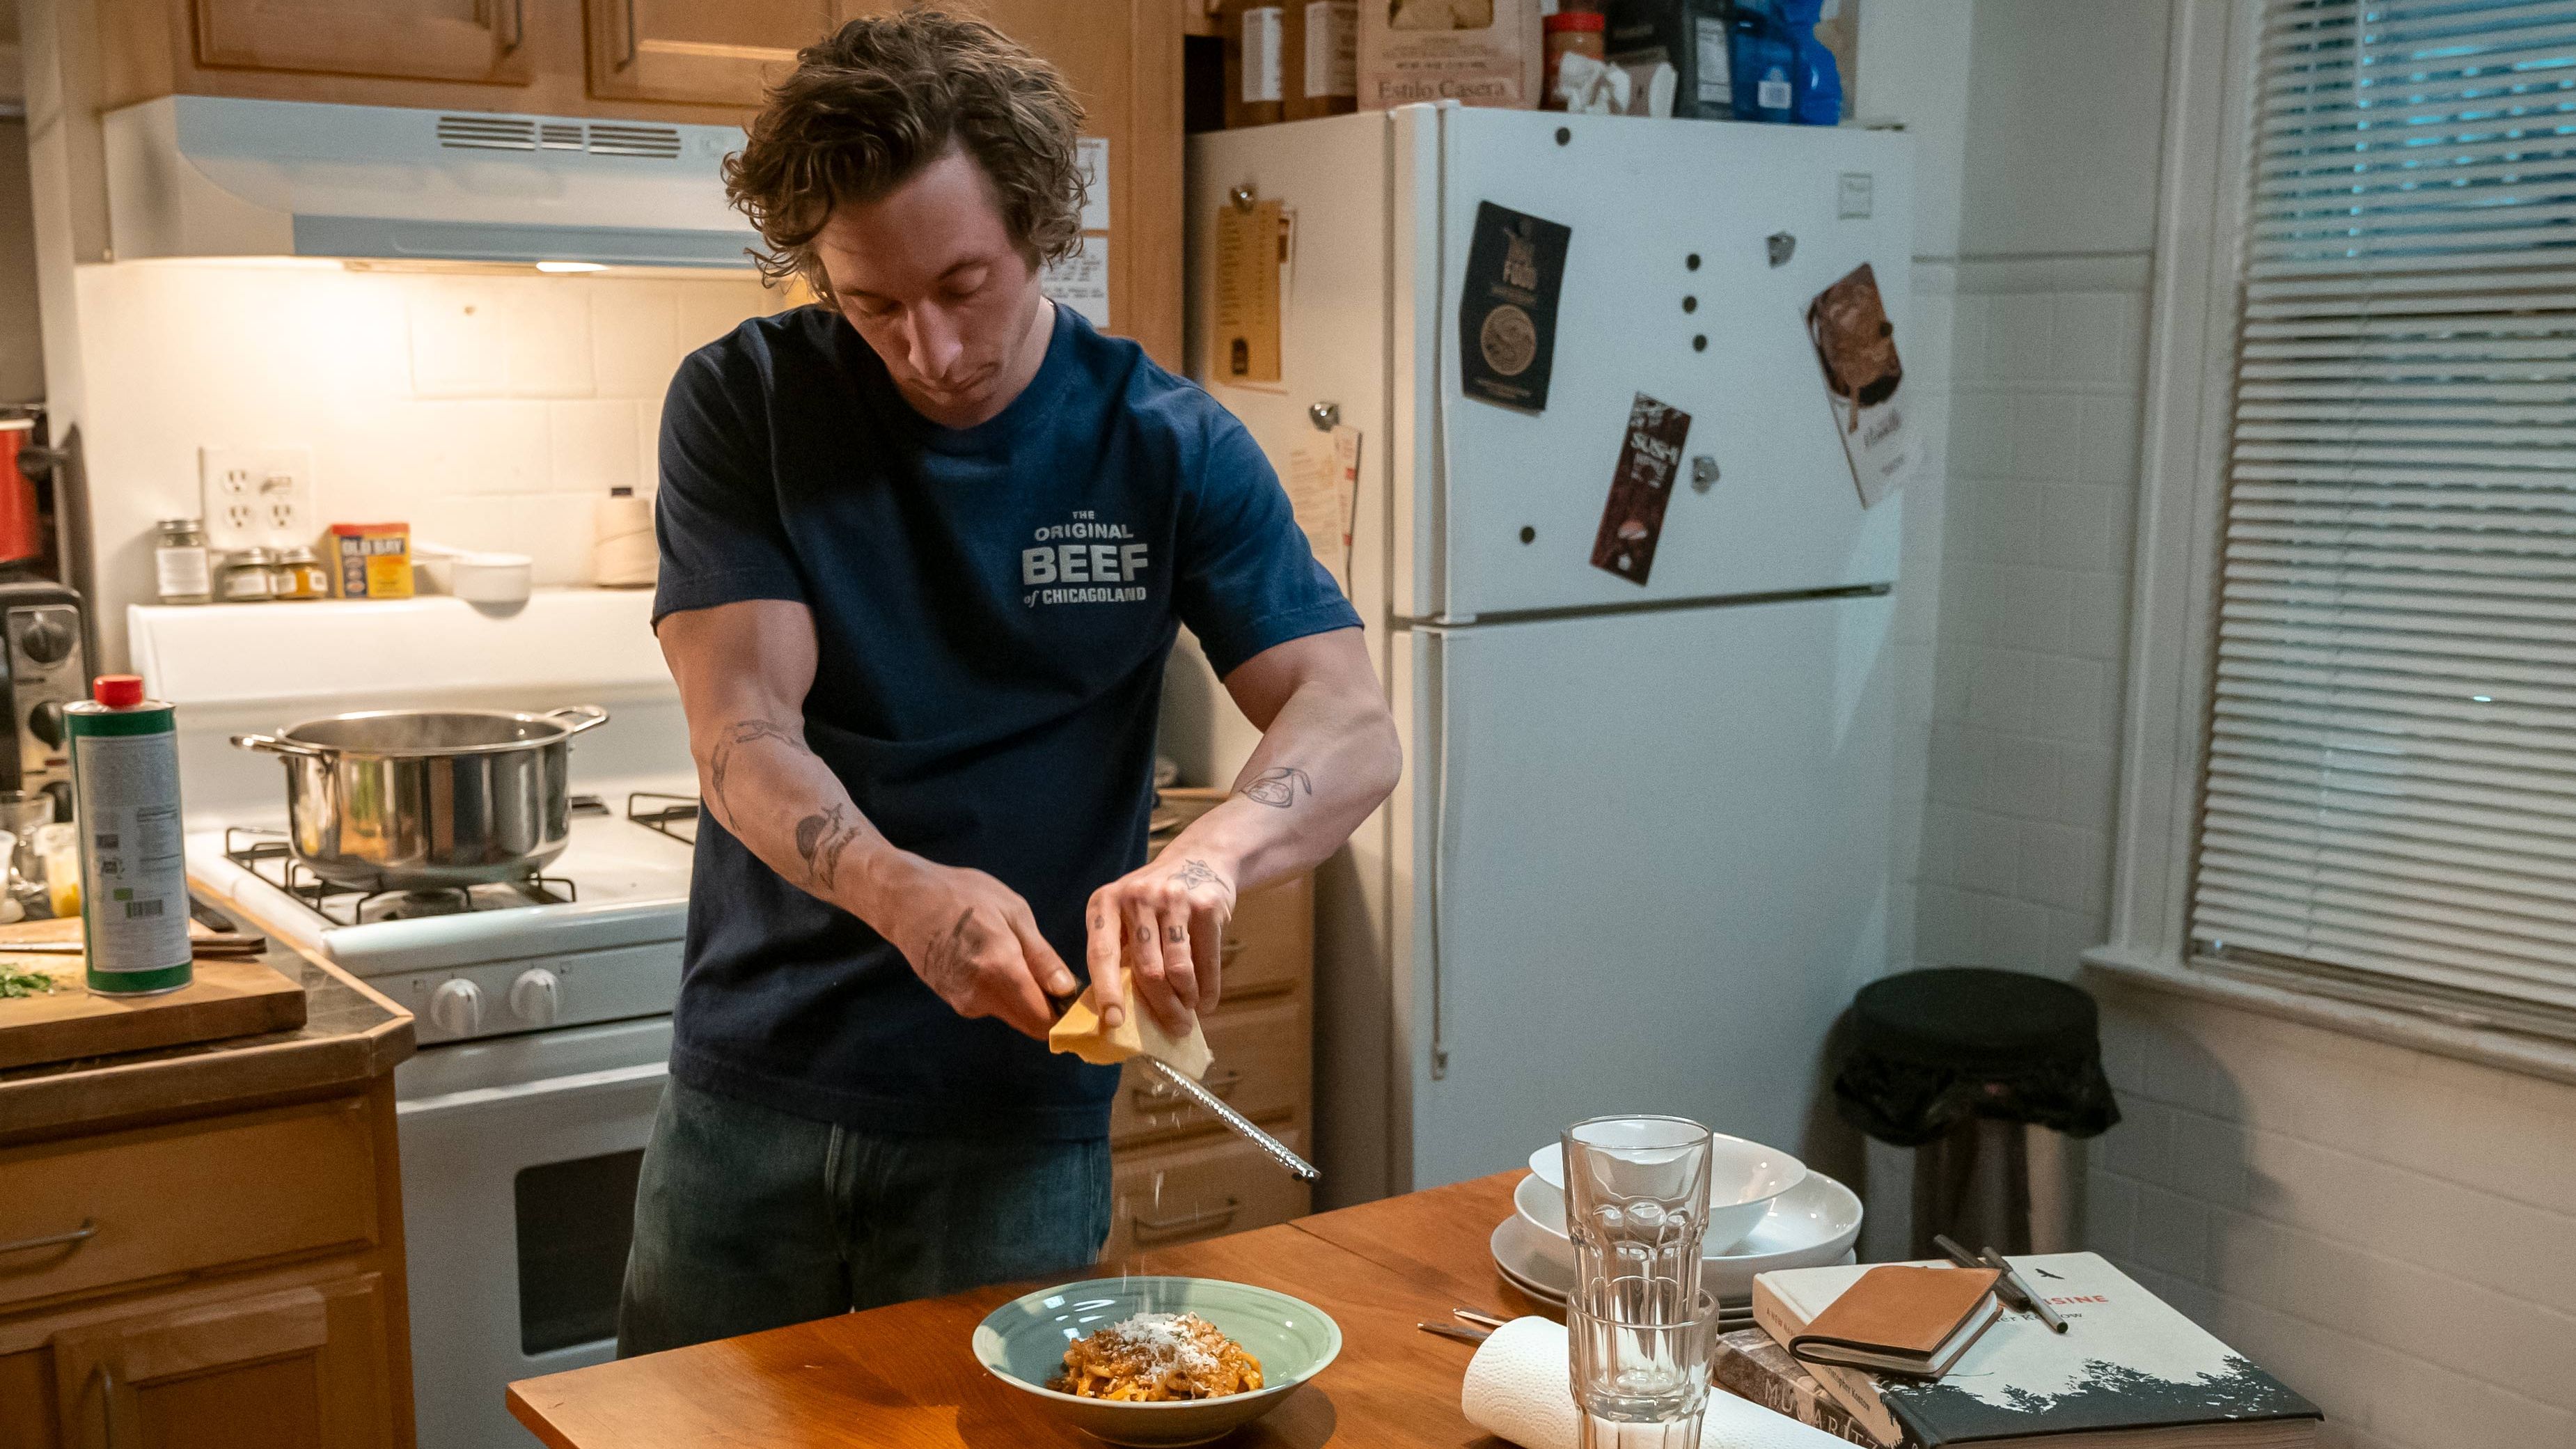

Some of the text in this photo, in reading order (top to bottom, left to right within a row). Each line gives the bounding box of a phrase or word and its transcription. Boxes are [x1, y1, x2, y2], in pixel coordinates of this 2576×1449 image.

[1377, 78, 1506, 100] Estilo Casera
[1072, 510, 1095, 519] THE
[1034, 522, 1134, 541] ORIGINAL
[1022, 543, 1148, 585] BEEF
[1023, 587, 1147, 609] of CHICAGOLAND
[2043, 1295, 2110, 1306] ISINE
